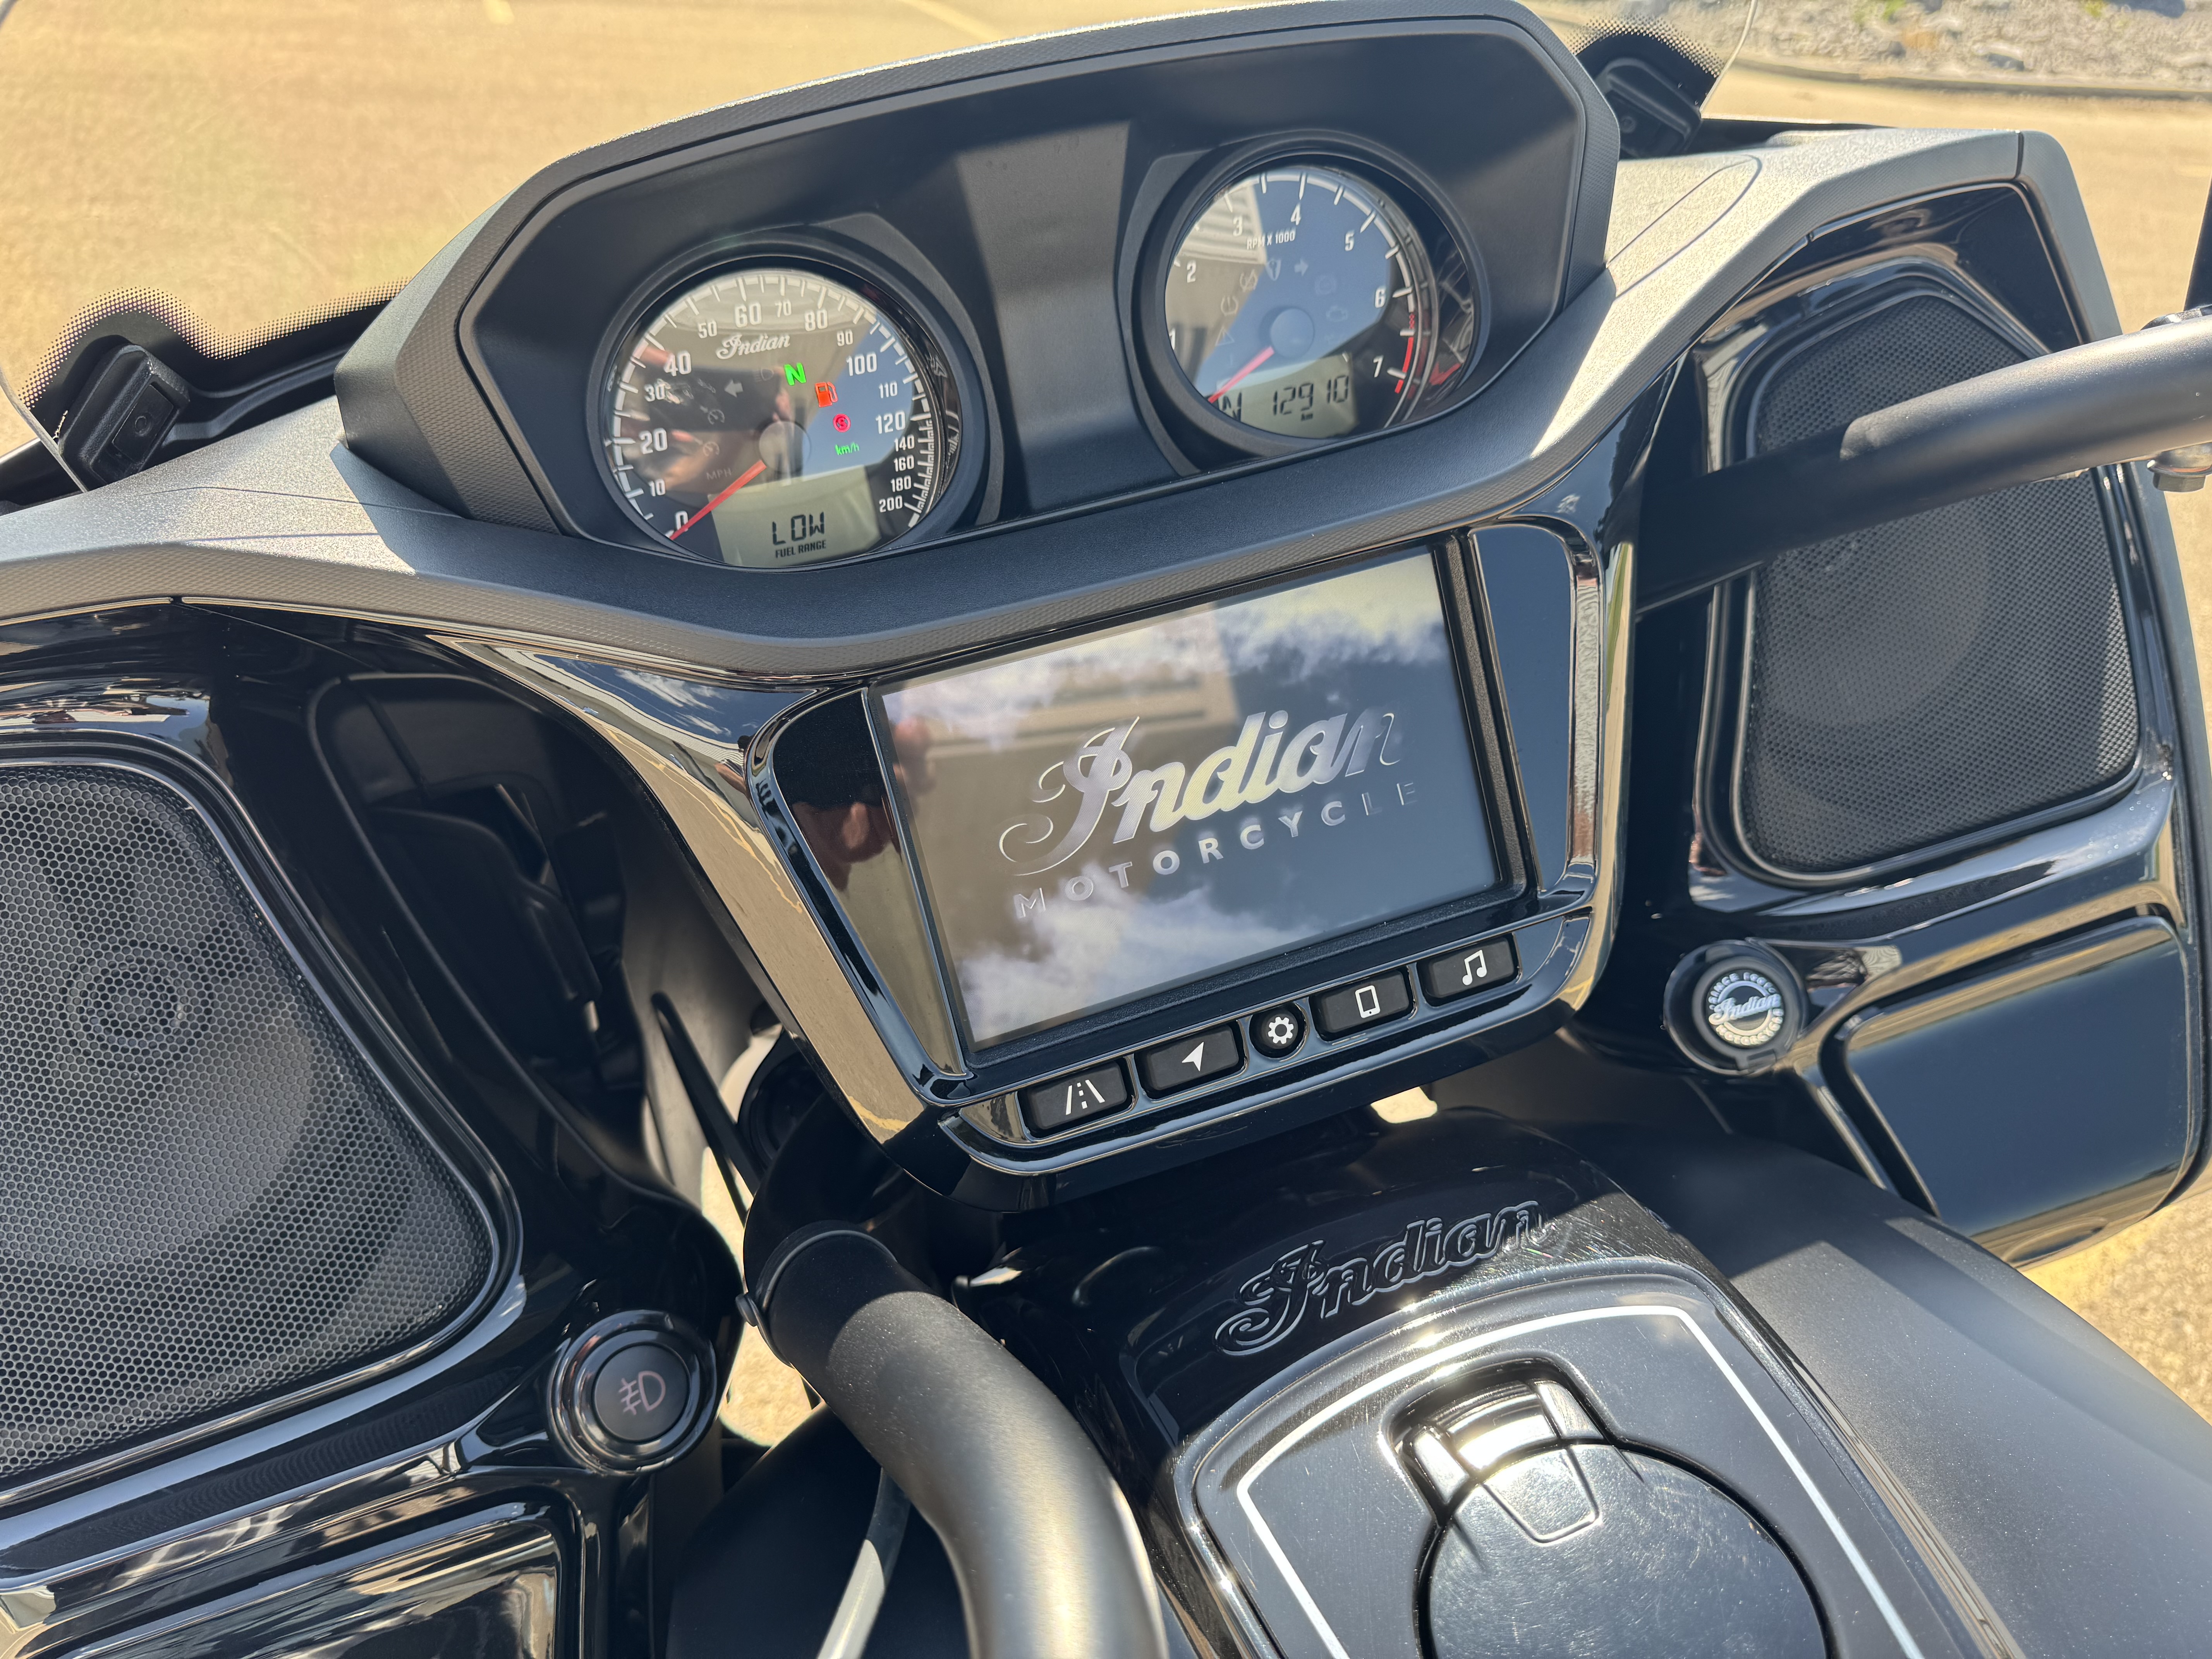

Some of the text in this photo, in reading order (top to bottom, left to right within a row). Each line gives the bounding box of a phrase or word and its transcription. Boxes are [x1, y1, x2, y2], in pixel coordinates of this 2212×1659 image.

[1291, 203, 1301, 225] 4
[1233, 215, 1242, 237] 3
[1246, 234, 1266, 250] RPM
[1275, 228, 1296, 244] 1000
[1345, 231, 1355, 251] 5
[1186, 261, 1197, 283] 2
[775, 299, 791, 318] 70
[1375, 287, 1386, 308] 6
[735, 302, 762, 328] 60
[804, 309, 828, 331] 80
[698, 319, 717, 338] 50
[837, 330, 853, 346] 90
[716, 333, 790, 359] Indian
[663, 350, 692, 376] 40
[784, 362, 806, 386] N
[846, 352, 877, 376] 100
[1373, 355, 1384, 378] 7
[644, 381, 665, 402] 30
[879, 381, 898, 398] 110
[1273, 375, 1349, 416] 12910
[876, 410, 905, 434] 120
[639, 428, 668, 454] 20
[835, 441, 860, 455] km/h
[894, 434, 915, 452] 140
[706, 468, 732, 480] MPH
[893, 454, 915, 472] 160
[648, 479, 665, 496] 10
[891, 476, 911, 492] 180
[879, 495, 903, 512] 200
[675, 510, 688, 532] 0
[772, 512, 824, 545] LOW
[775, 540, 826, 558] FUEL RANGE
[999, 709, 1401, 876] Indian
[1013, 781, 1418, 919] MOTORCYCLE
[1709, 994, 1781, 1025] Indian
[1716, 1008, 1784, 1046] MOTORCYCLE
[1214, 1200, 1552, 1356] Indian
